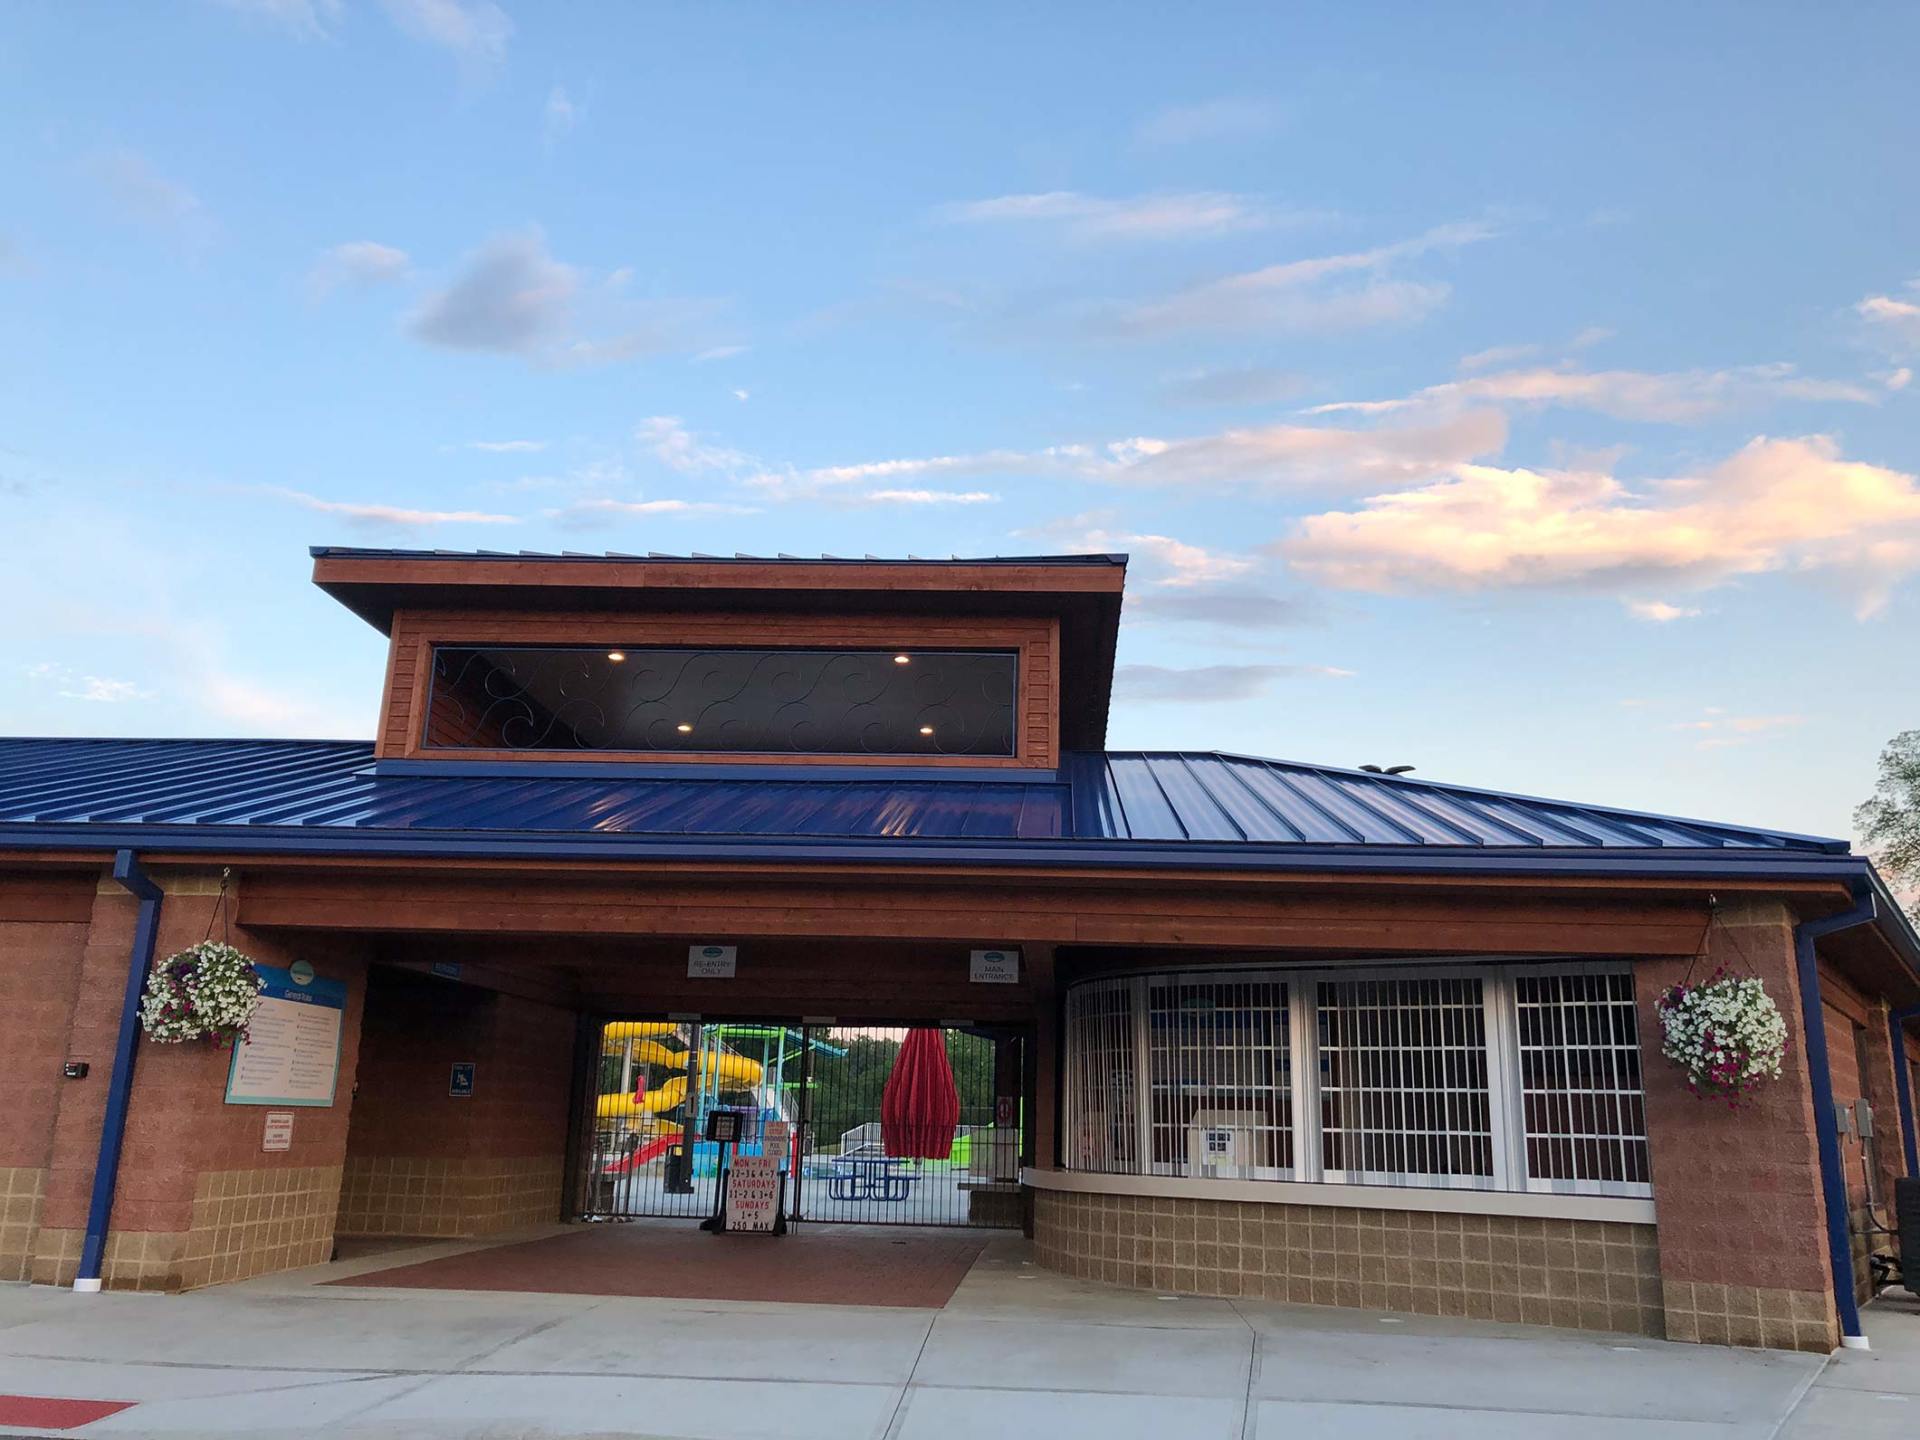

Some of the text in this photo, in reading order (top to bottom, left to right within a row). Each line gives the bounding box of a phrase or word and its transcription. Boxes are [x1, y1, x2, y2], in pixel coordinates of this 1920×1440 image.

[735, 1159, 749, 1168] MON
[758, 1159, 771, 1168] FRI
[732, 1179, 776, 1189] SATURDAYS
[735, 1200, 769, 1209] SUNDAYS
[732, 1221, 769, 1231] 250 MAX
